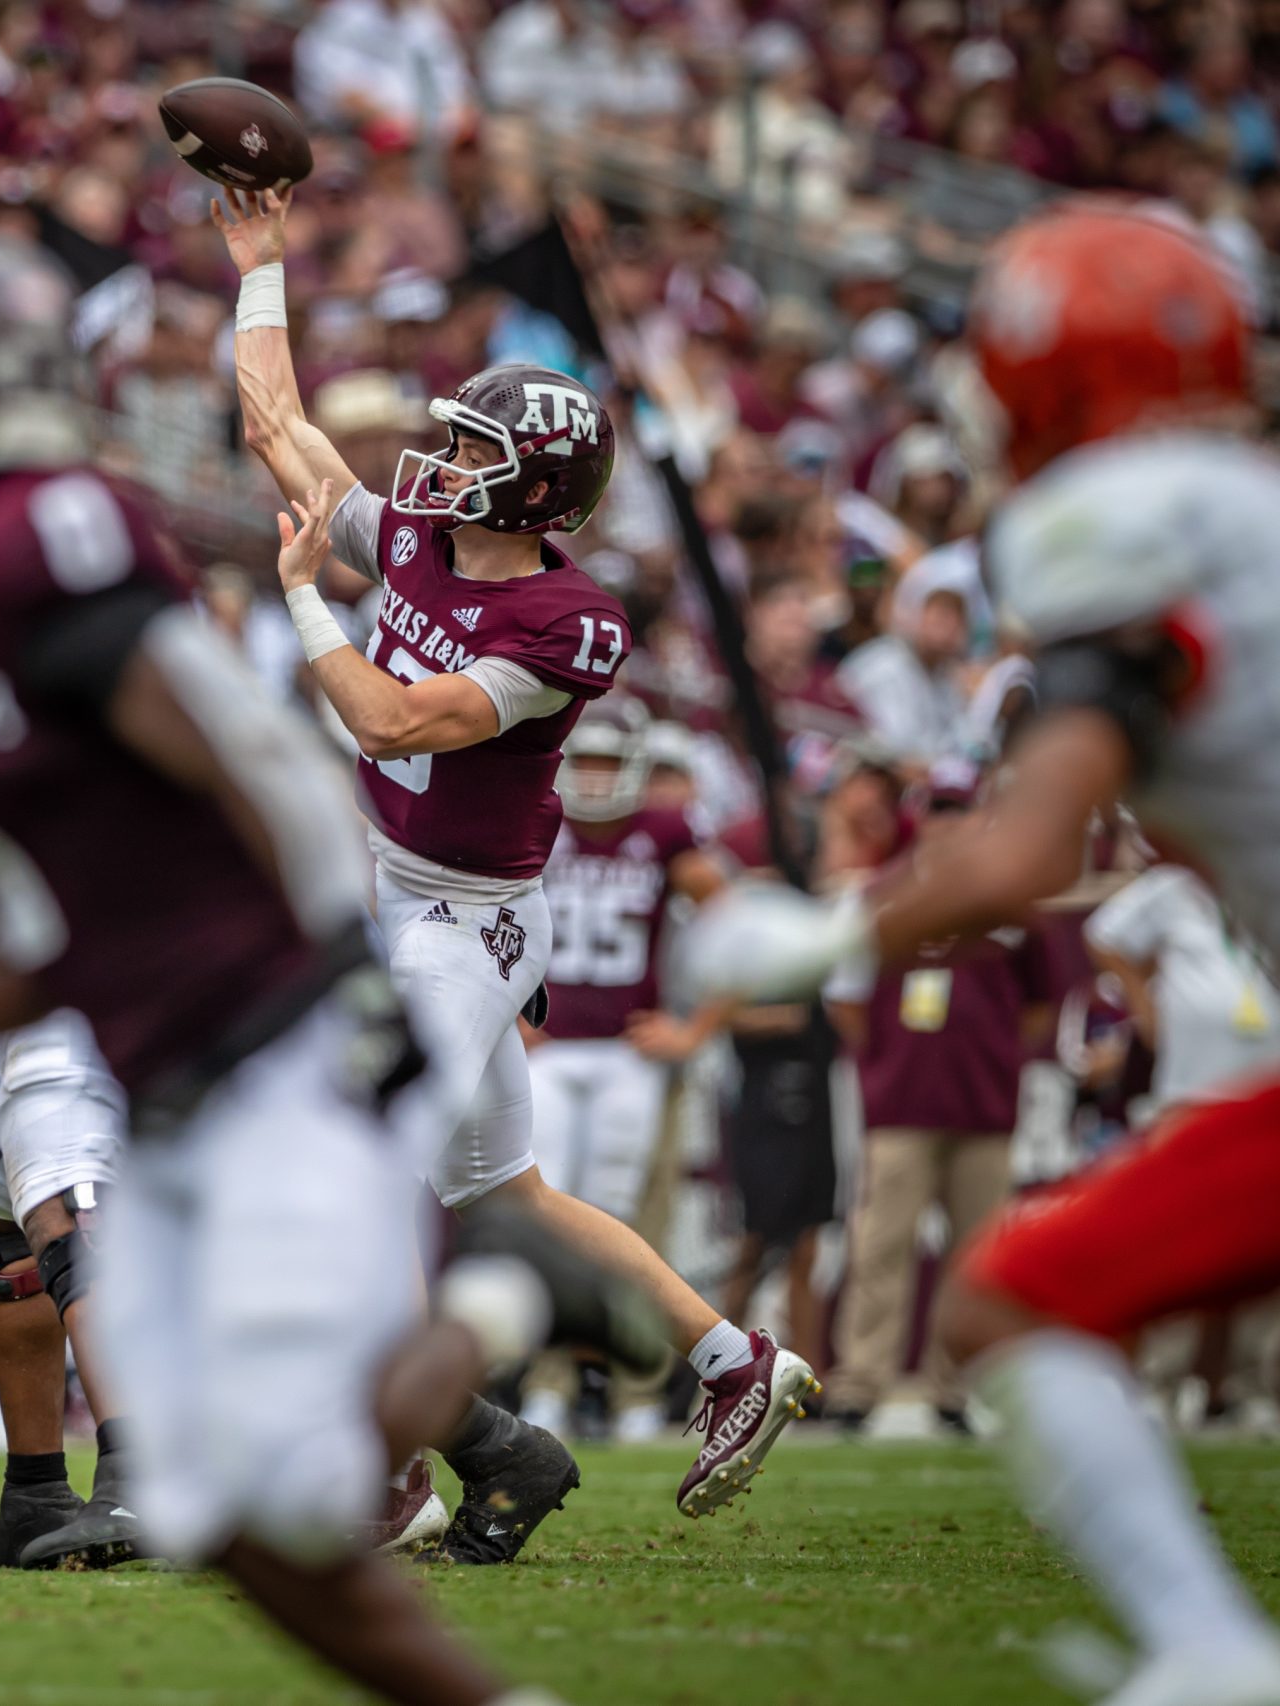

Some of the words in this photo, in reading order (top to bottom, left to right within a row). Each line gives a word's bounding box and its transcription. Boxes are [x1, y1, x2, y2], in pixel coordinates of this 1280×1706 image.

[391, 527, 417, 565] SEC
[451, 608, 477, 633] adidas
[419, 624, 477, 674] A&M
[571, 615, 625, 675] 13
[419, 910, 458, 925] adidas
